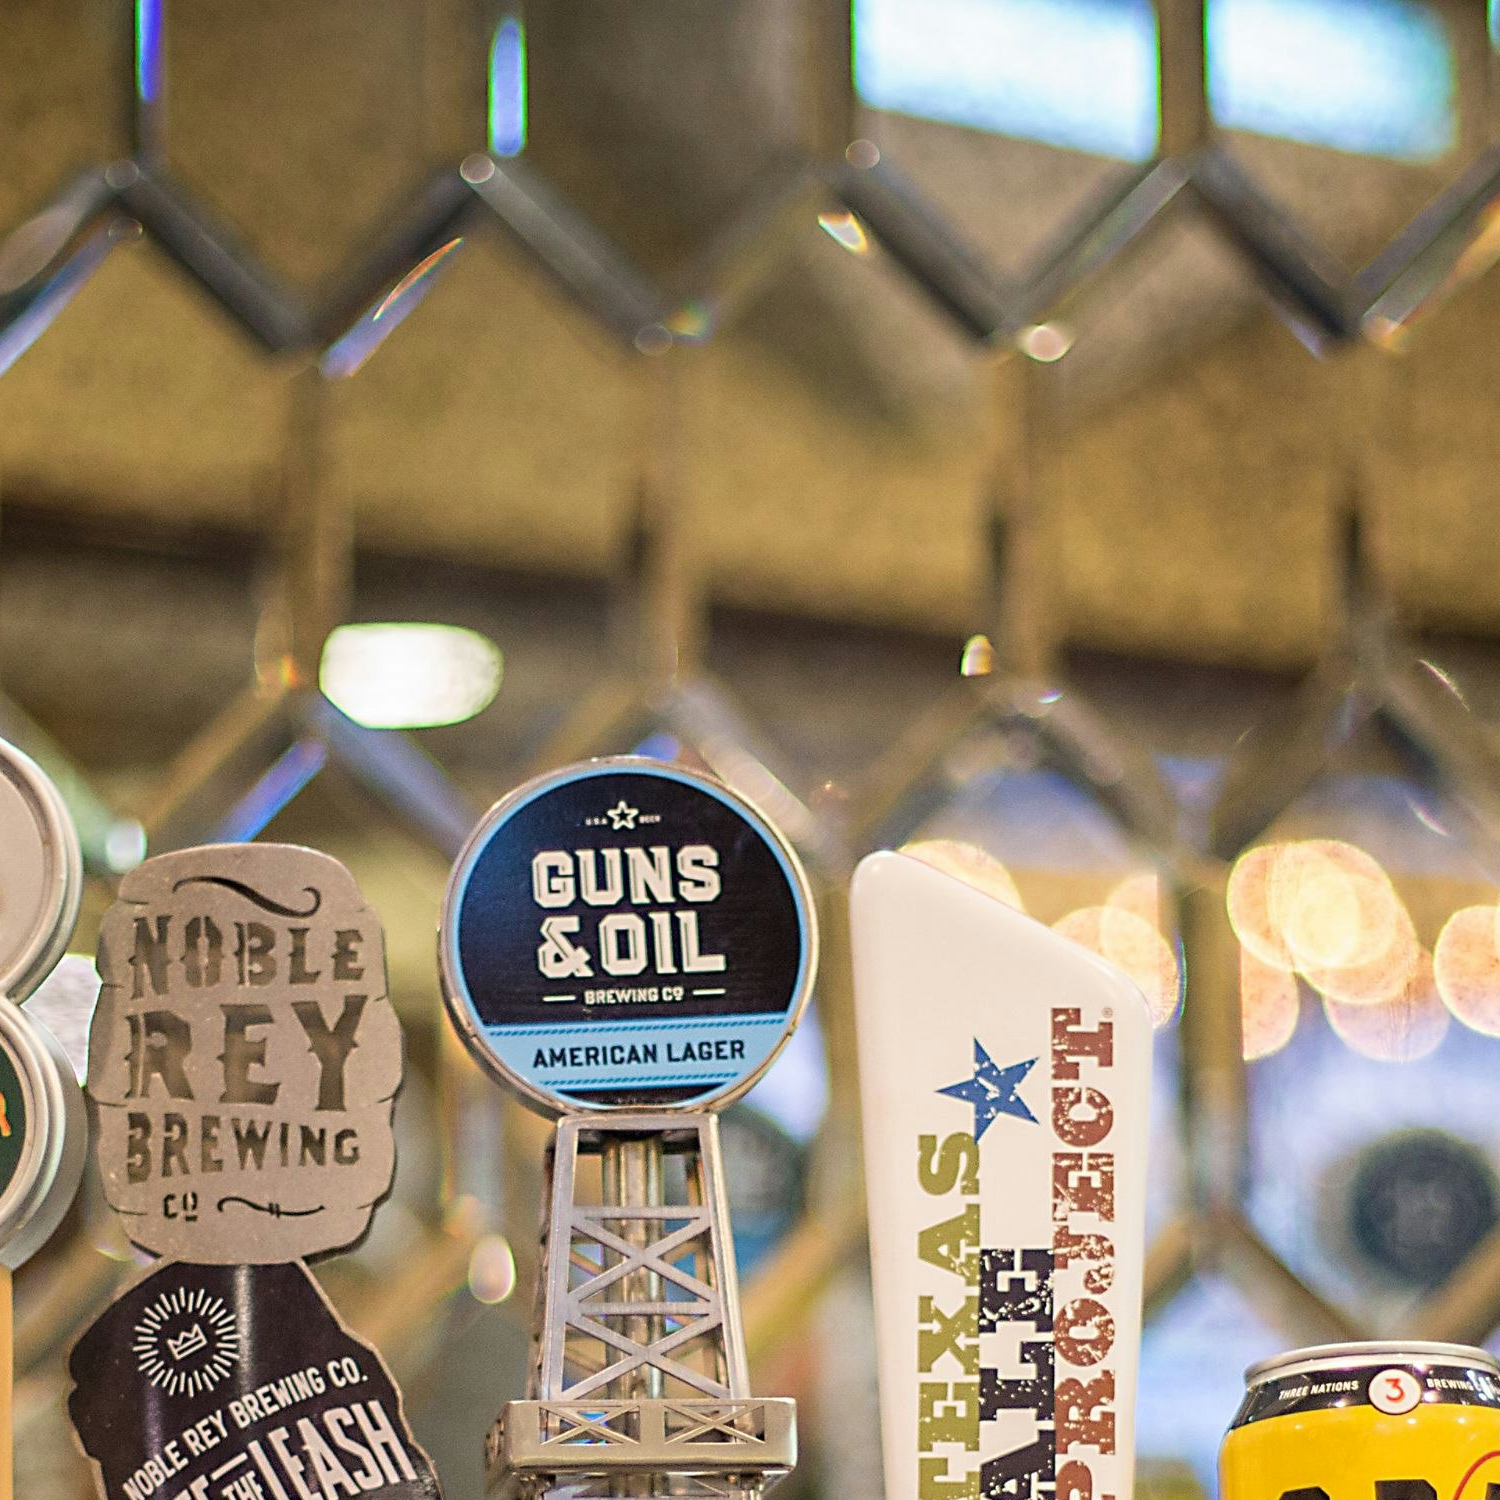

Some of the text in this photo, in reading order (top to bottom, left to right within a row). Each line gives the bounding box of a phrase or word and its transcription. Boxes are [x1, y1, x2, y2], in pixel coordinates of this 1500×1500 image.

[531, 844, 722, 909] GUNS
[128, 914, 367, 999] NOBLE
[598, 910, 727, 977] OIL
[584, 988, 659, 1006] BREWING
[124, 994, 369, 1112] REY
[532, 1039, 746, 1069] AMERICAN LAGER
[126, 1112, 361, 1185] BREWING
[162, 1191, 199, 1223] CO
[181, 1409, 230, 1458] REY
[228, 1366, 328, 1430] BREWING
[326, 1355, 370, 1389] CO.
[1278, 1380, 1359, 1401] THREE NATIONS
[1384, 1378, 1407, 1402] 3
[1425, 1378, 1474, 1393] BREWING
